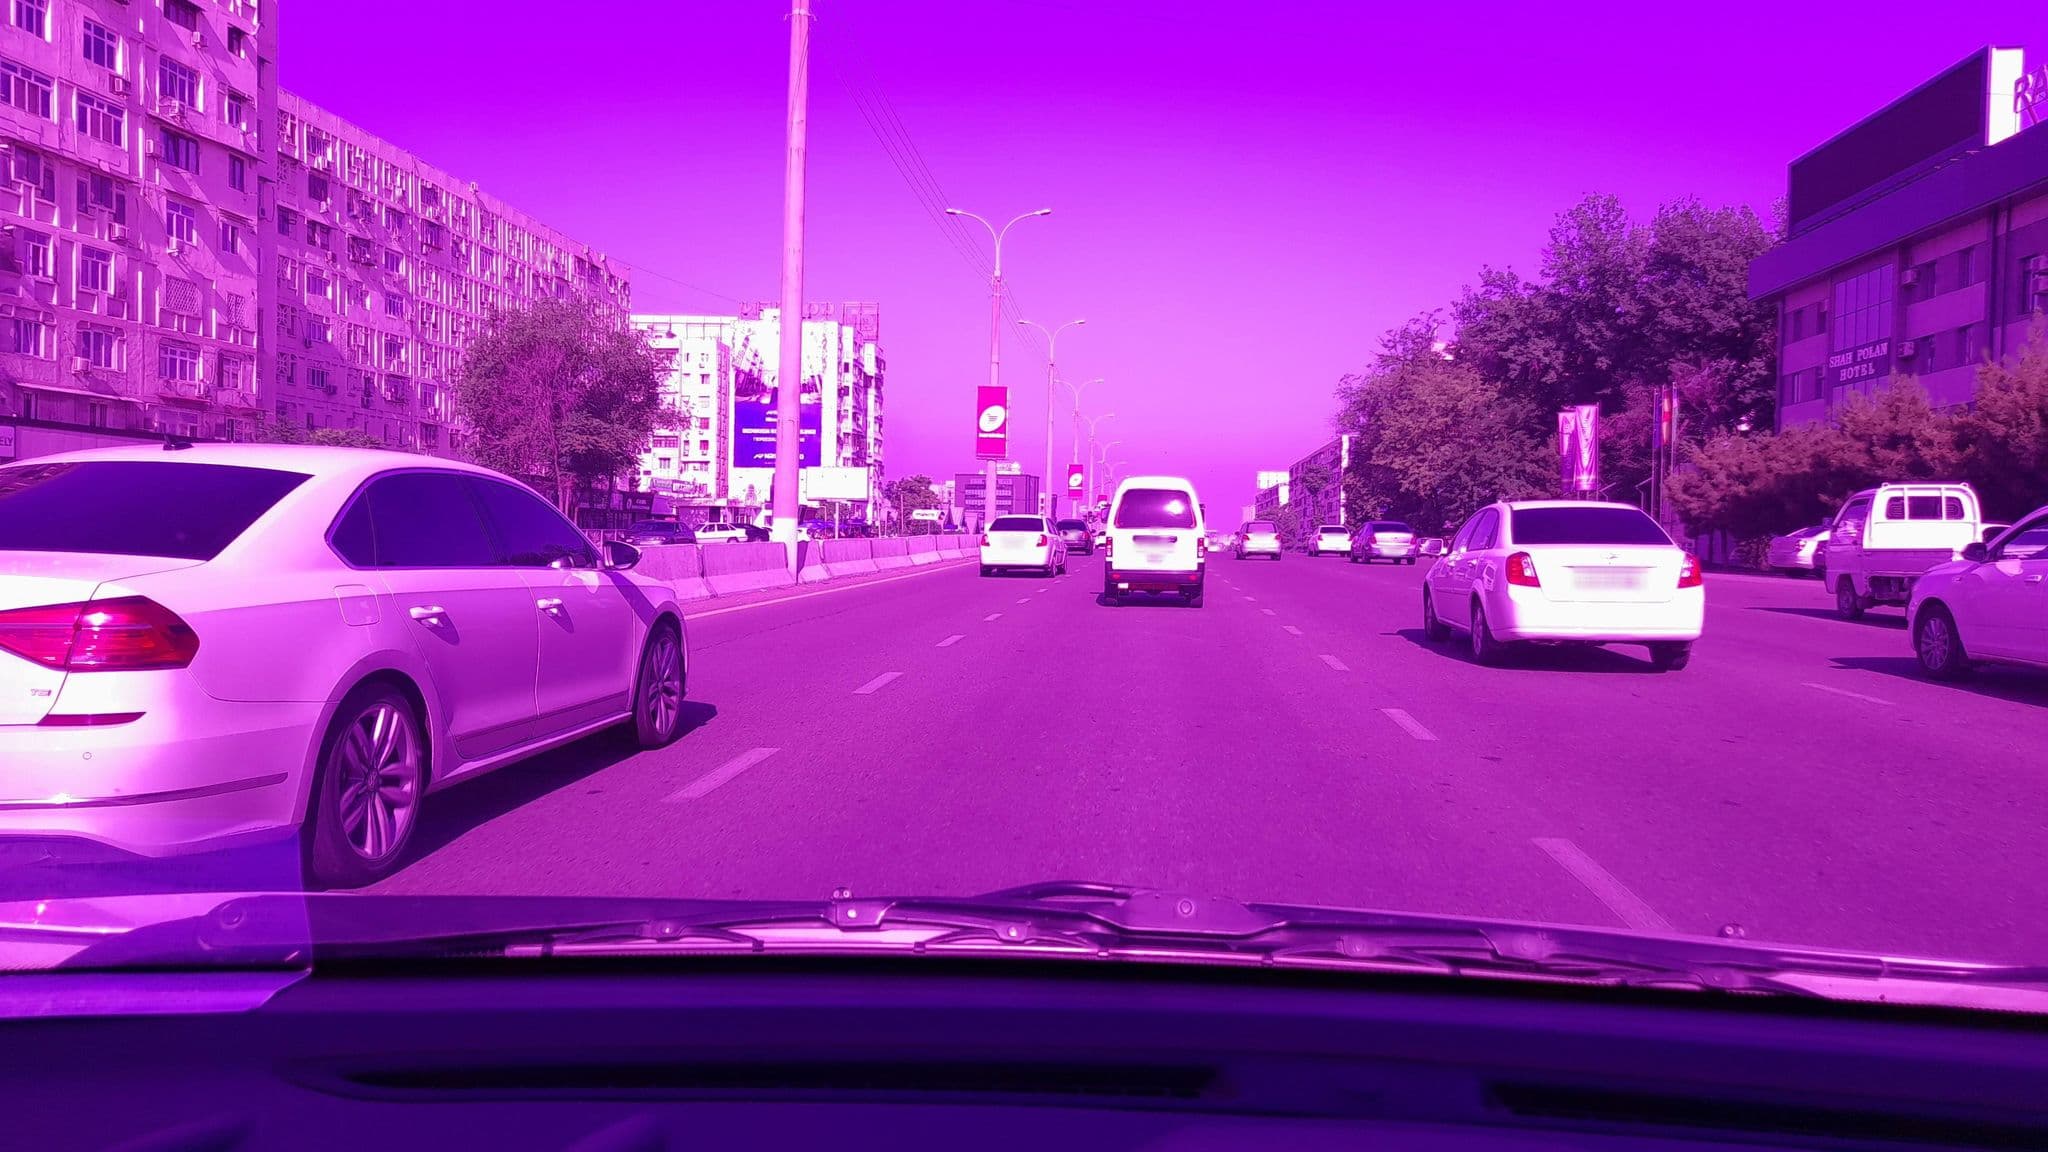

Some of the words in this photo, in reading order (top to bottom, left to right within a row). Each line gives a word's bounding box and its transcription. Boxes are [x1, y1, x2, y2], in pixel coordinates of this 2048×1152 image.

[1829, 352, 1853, 368] SHAH
[1857, 342, 1888, 361] POLAN
[1840, 362, 1875, 381] HOTEL
